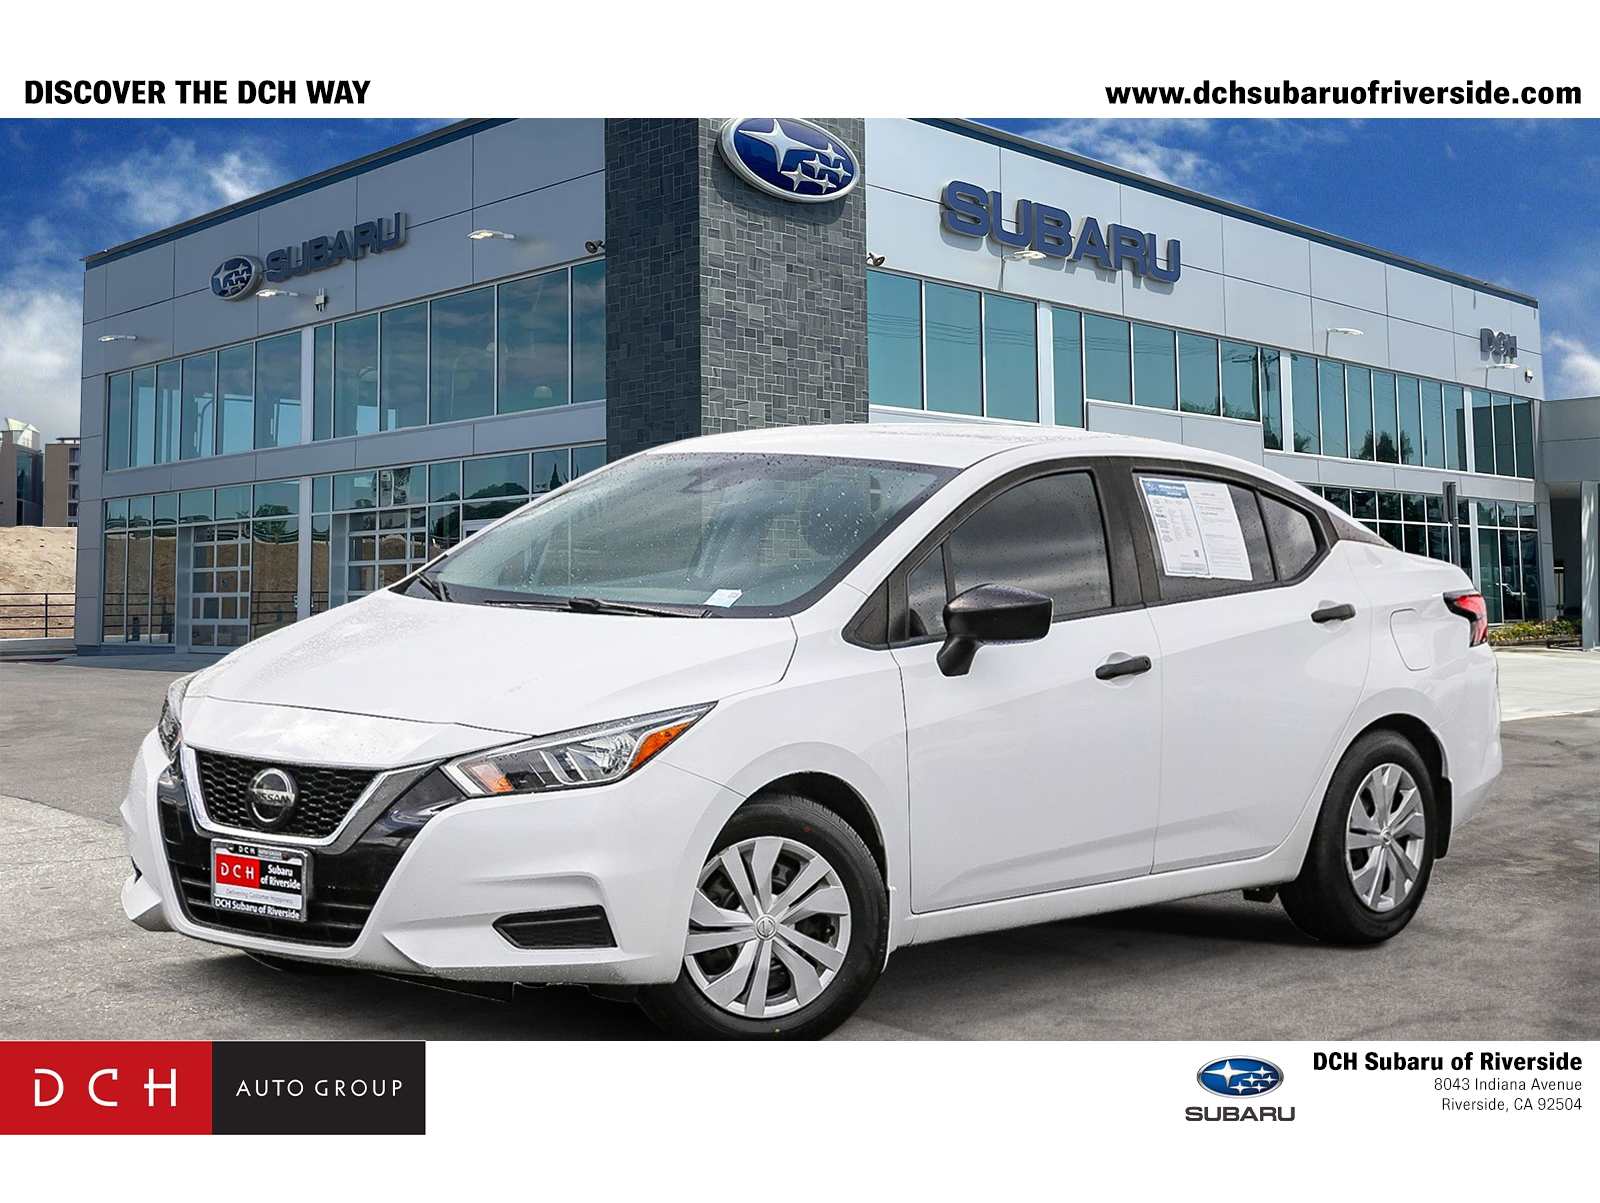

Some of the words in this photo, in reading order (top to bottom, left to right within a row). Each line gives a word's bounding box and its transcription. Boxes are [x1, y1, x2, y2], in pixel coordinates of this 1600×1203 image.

[941, 180, 1182, 284] SUBARU
[265, 211, 407, 283] SUBARU
[220, 862, 255, 880] DCH
[267, 864, 294, 877] Subaru
[260, 875, 268, 885] of
[269, 876, 301, 890] Riverside
[215, 898, 231, 908] DCH
[232, 901, 258, 913] Subaru
[258, 905, 267, 914] of
[267, 906, 300, 920] Riverside
